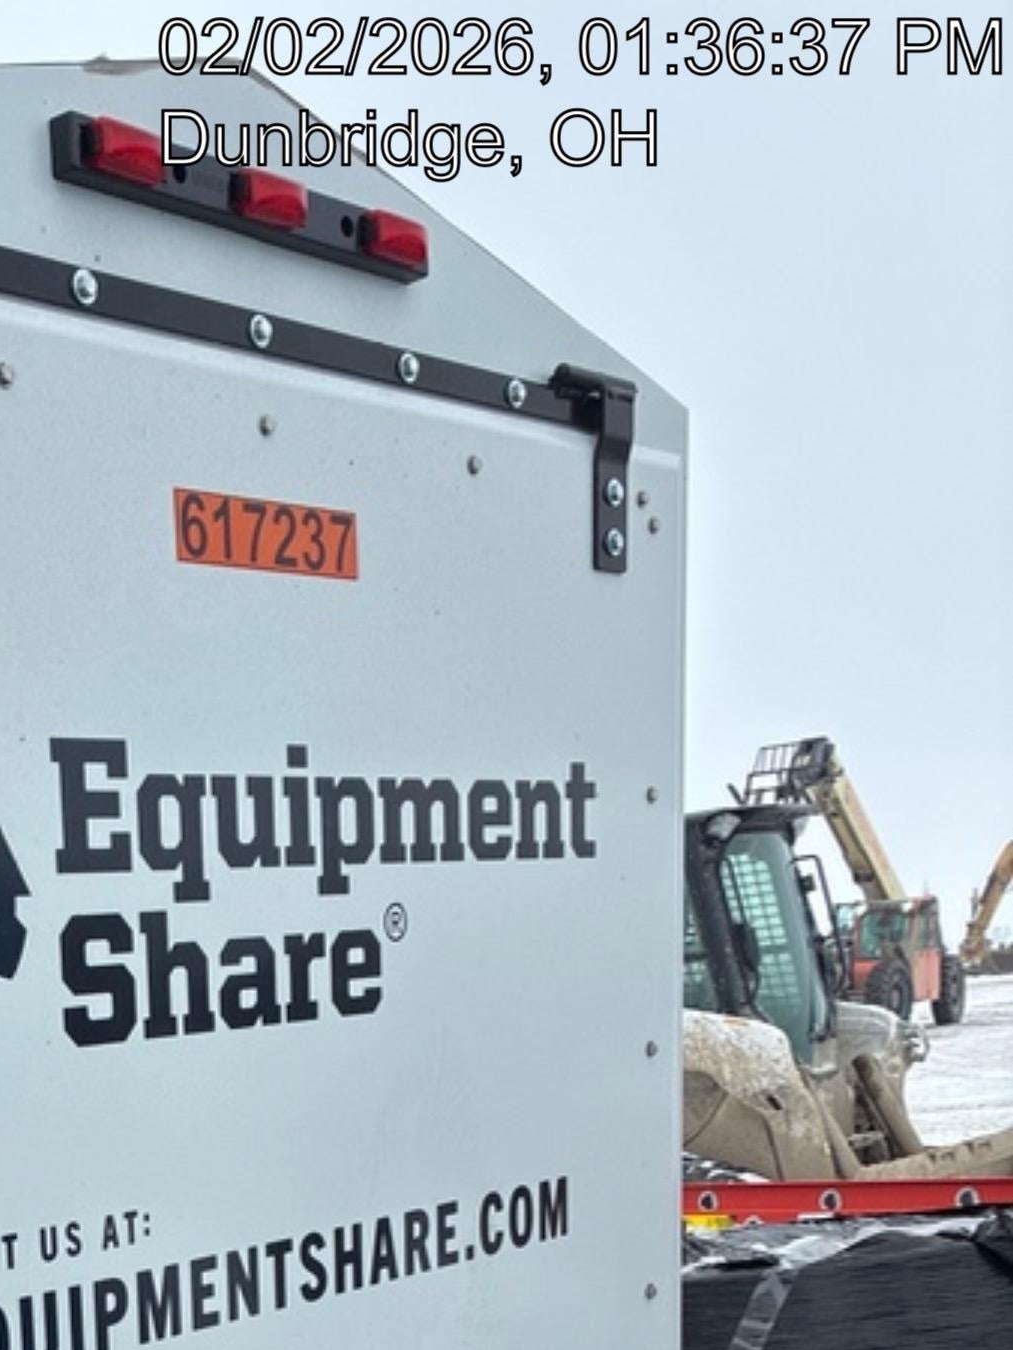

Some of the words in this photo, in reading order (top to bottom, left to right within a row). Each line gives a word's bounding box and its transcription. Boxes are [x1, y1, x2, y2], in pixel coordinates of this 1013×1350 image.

[180, 493, 355, 574] 617237
[49, 737, 596, 903] Equipment
[39, 1222, 83, 1262] US
[102, 1210, 152, 1252] AT:
